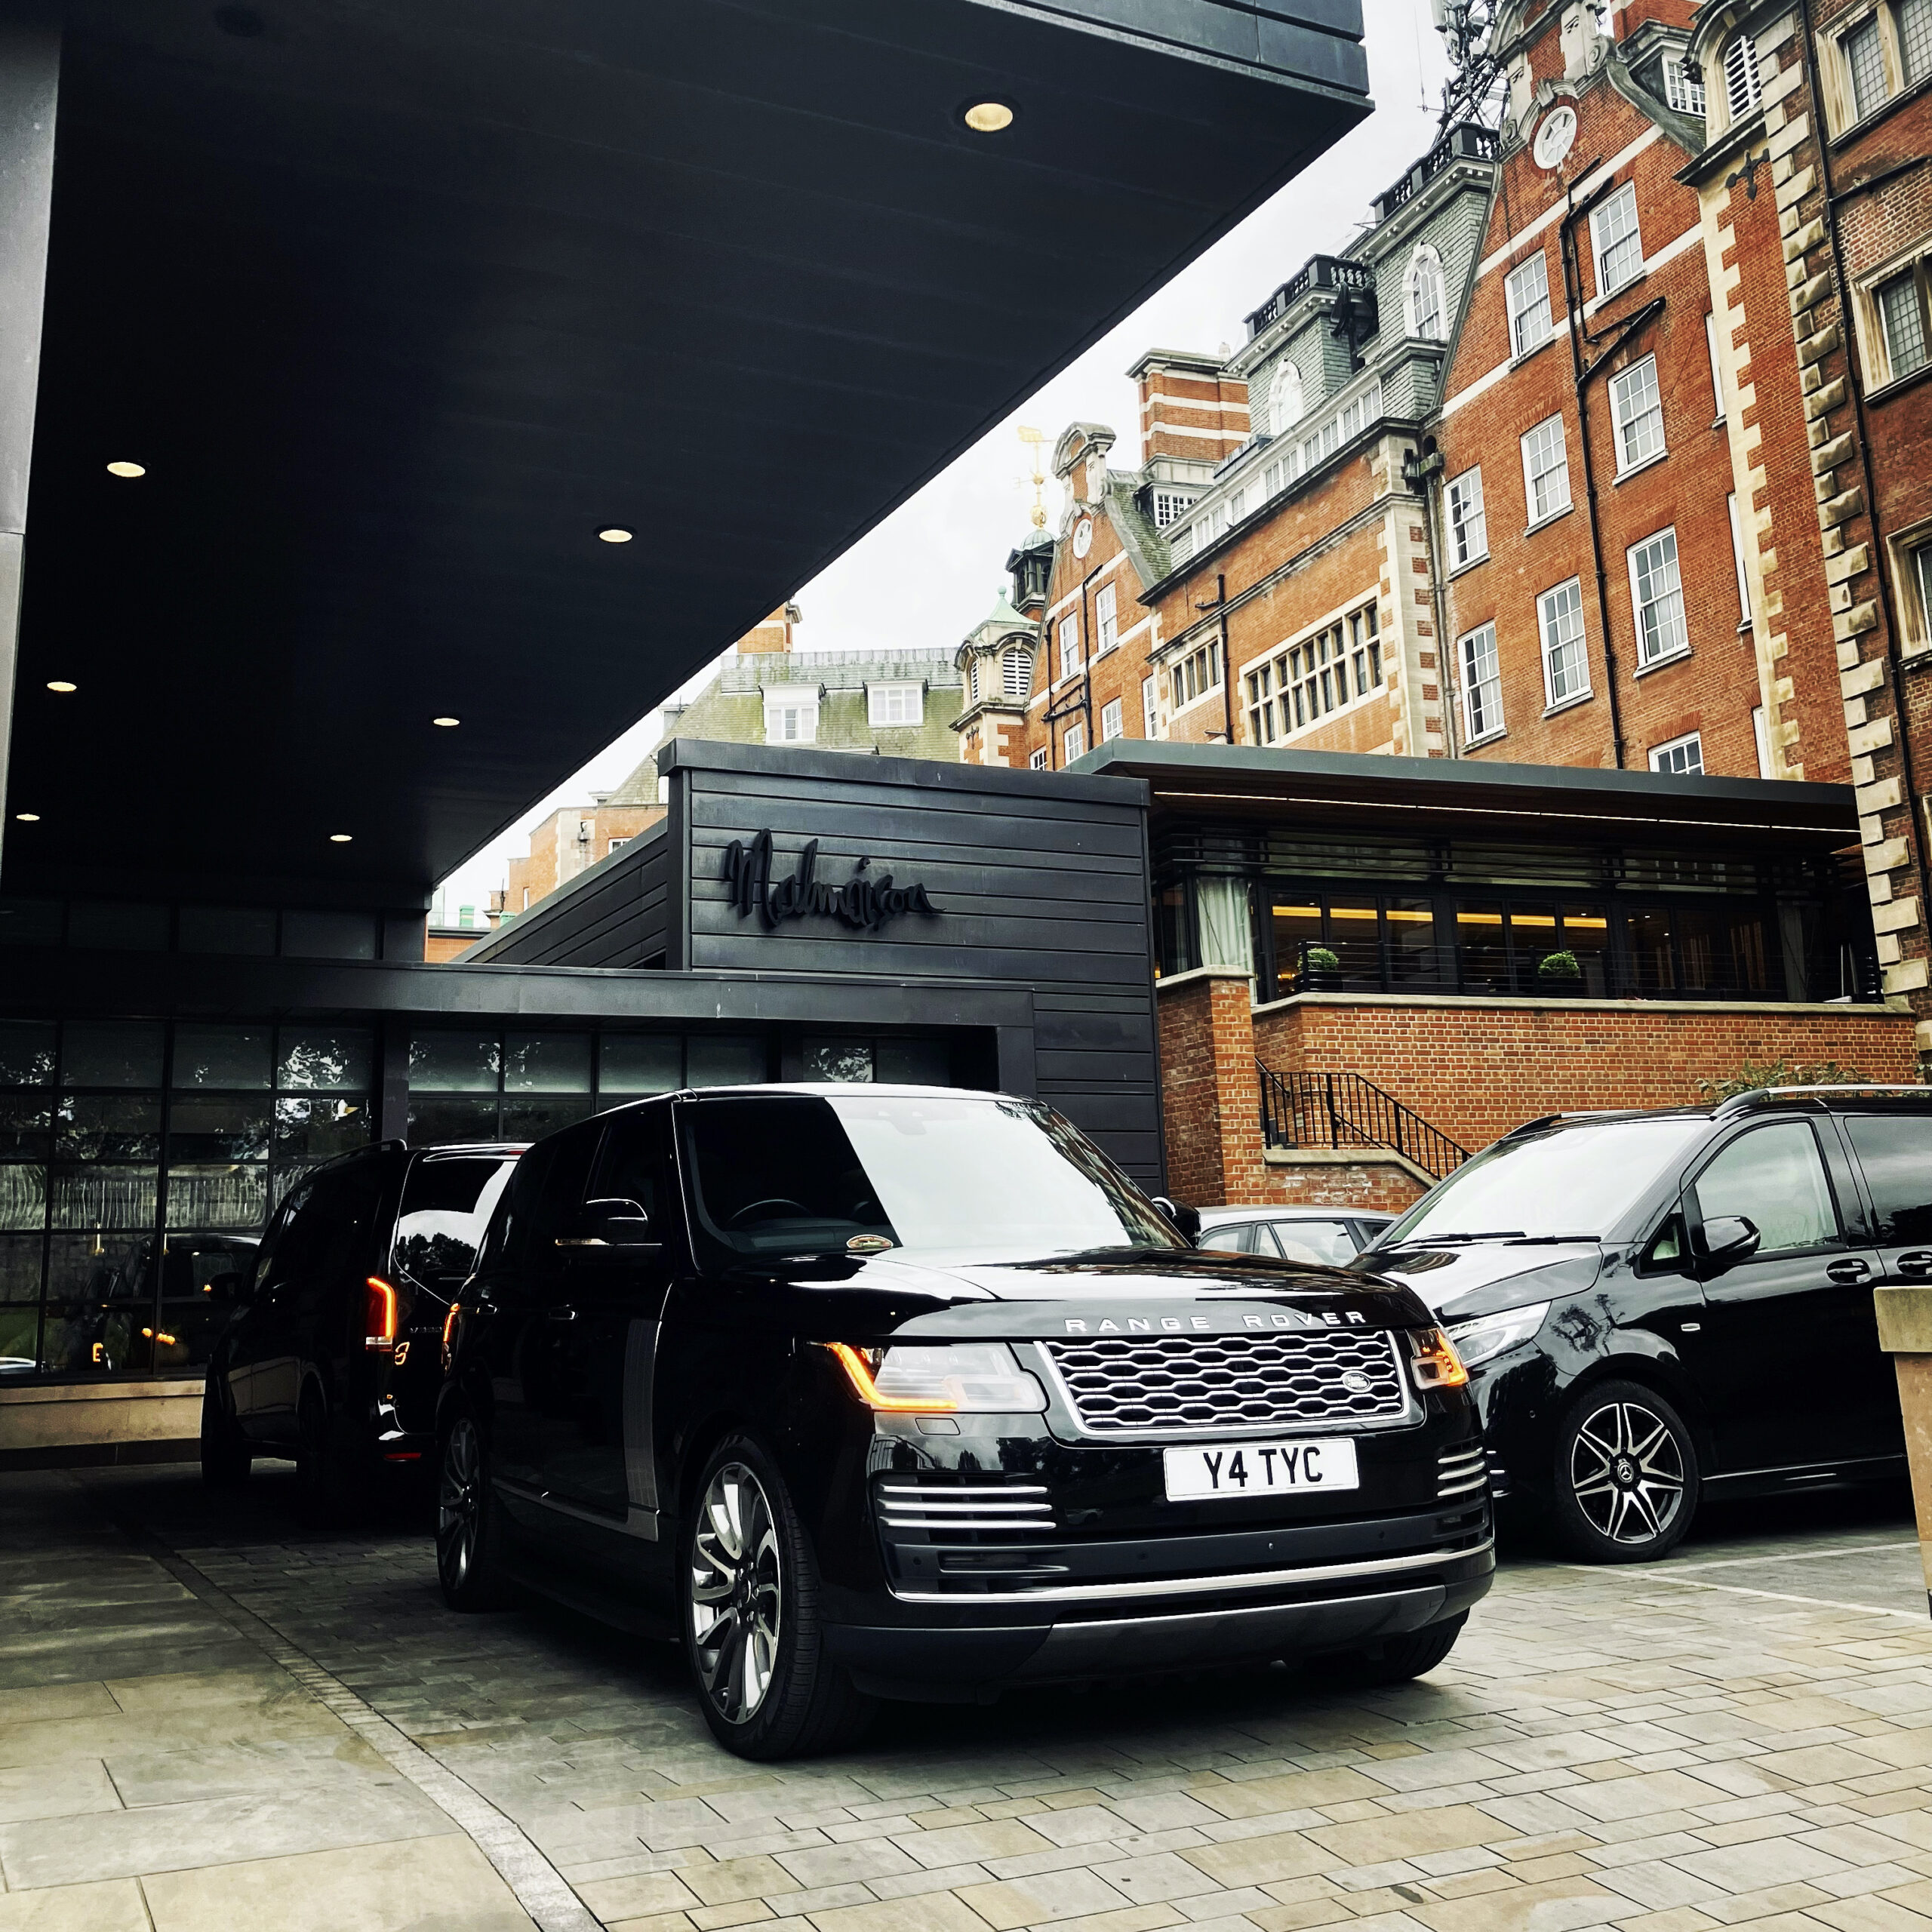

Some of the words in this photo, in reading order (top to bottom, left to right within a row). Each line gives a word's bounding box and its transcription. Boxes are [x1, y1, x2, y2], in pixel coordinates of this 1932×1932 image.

[724, 828, 946, 930] Malmaison
[1064, 1316, 1210, 1332] RANGE
[1242, 1311, 1366, 1327] ROVER
[1203, 1451, 1248, 1489] Y4
[1258, 1446, 1323, 1486] TYC
